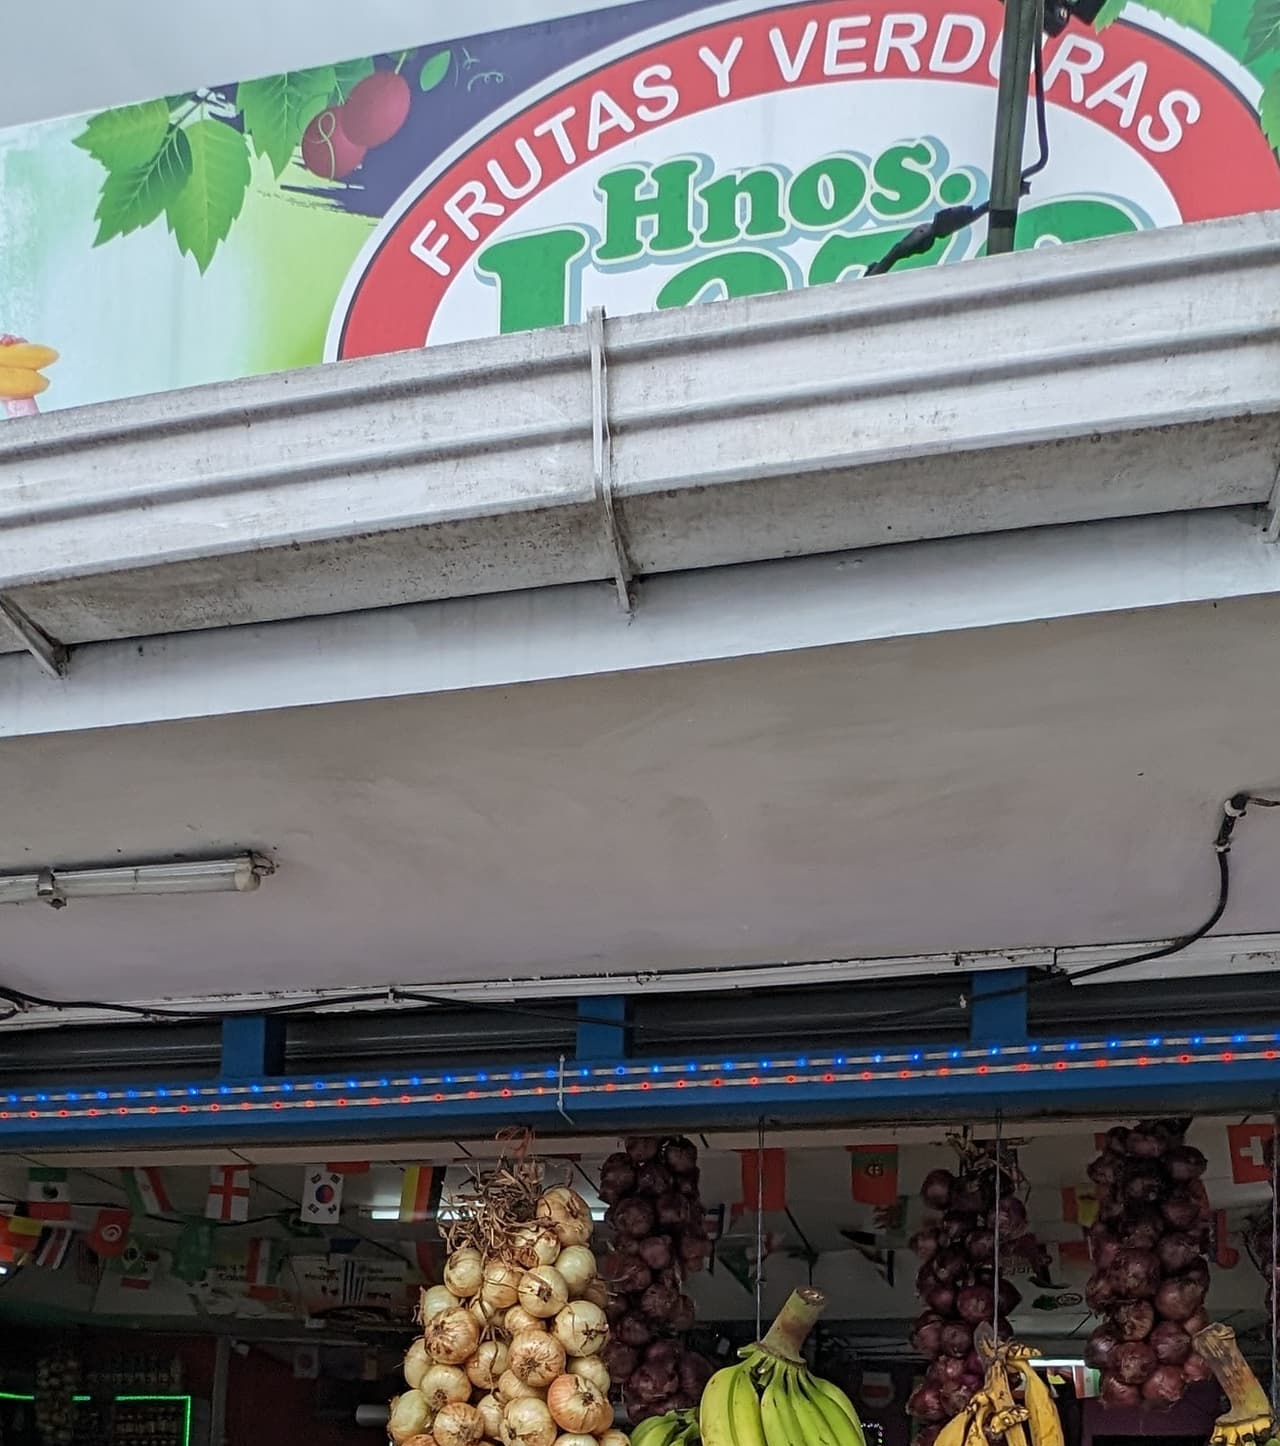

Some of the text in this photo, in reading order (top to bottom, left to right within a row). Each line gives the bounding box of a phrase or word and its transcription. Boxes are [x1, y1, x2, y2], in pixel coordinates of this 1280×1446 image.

[410, 63, 680, 277] FRUTAS
[700, 36, 743, 98] Y
[596, 138, 972, 264] Hnos.
